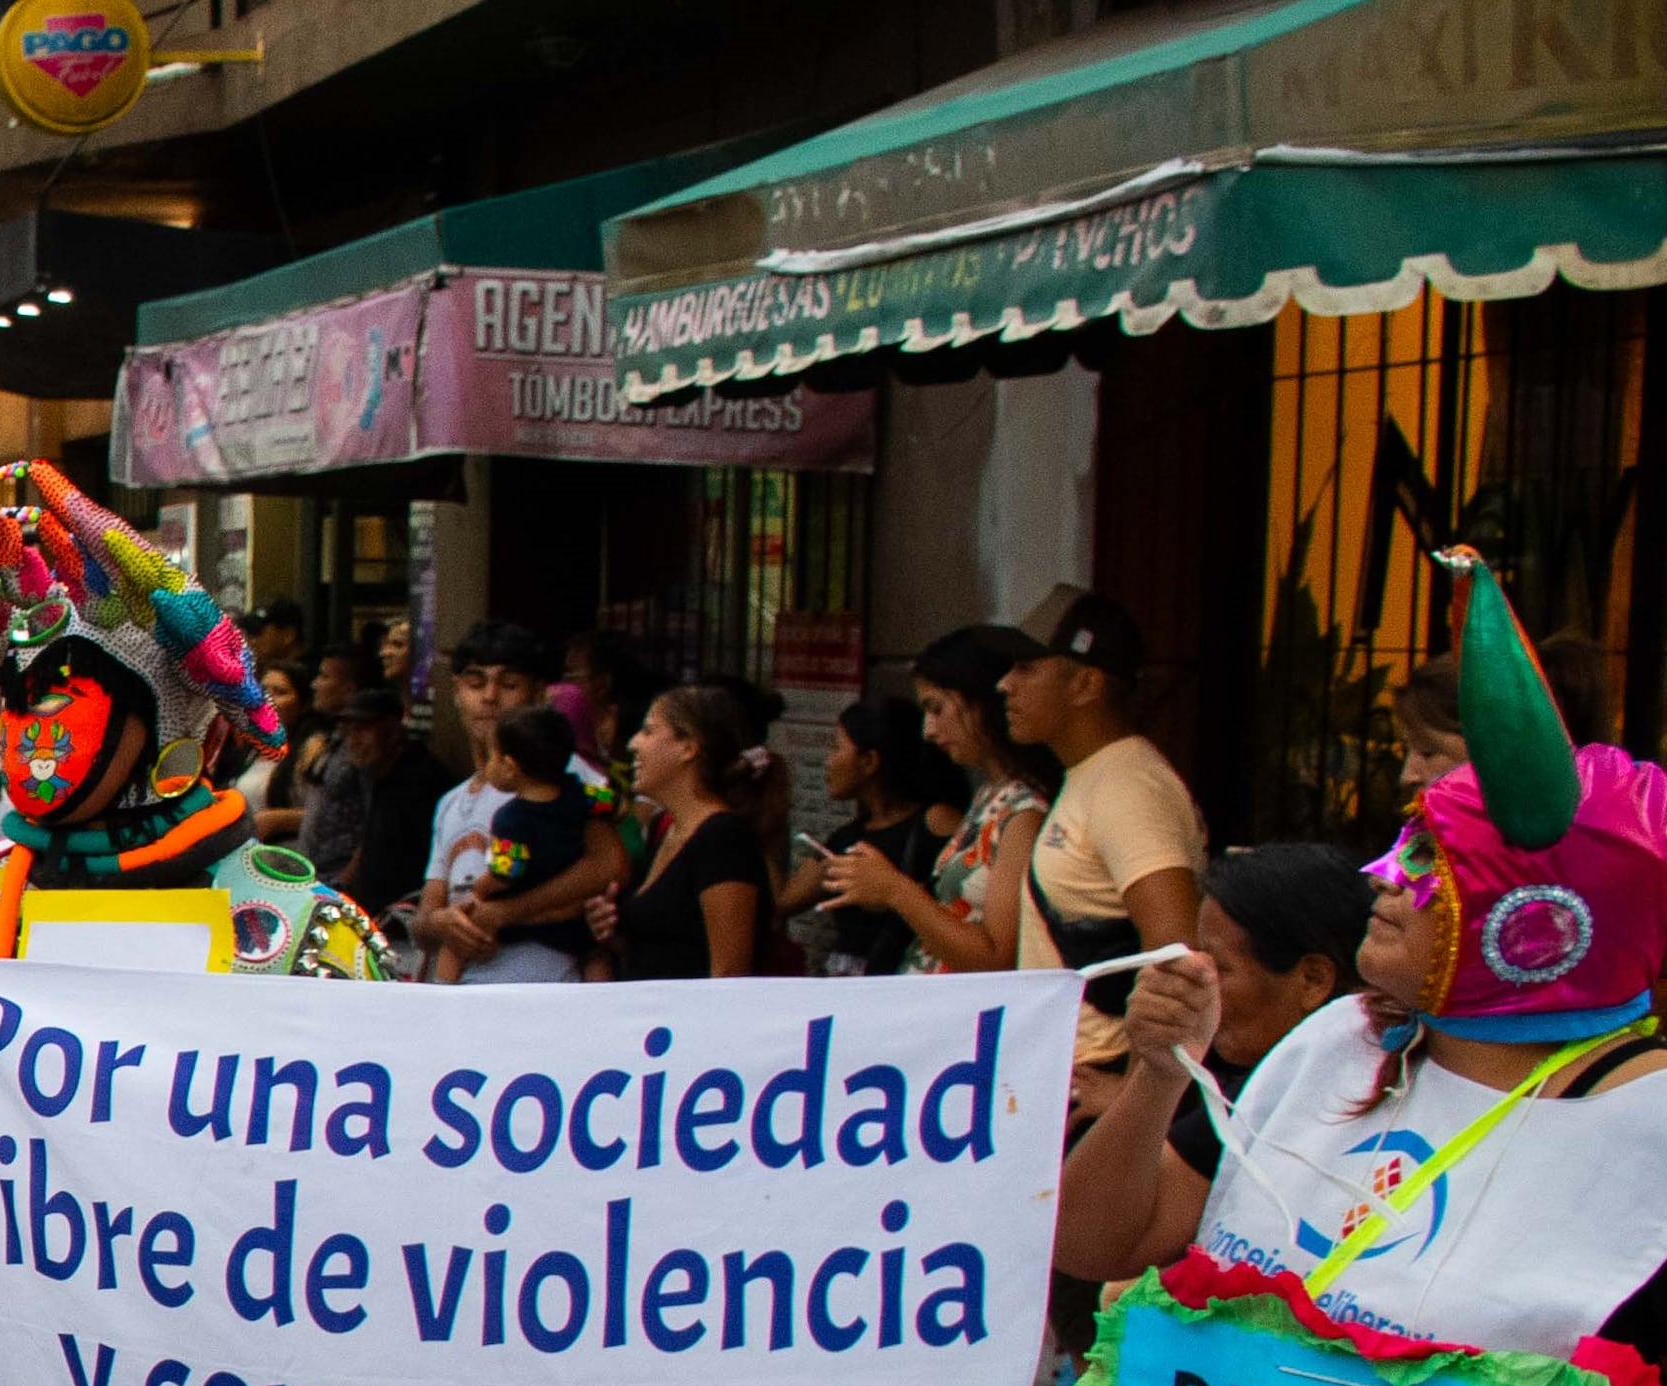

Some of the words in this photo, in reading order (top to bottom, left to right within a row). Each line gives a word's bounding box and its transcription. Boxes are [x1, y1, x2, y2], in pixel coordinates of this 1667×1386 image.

[21, 28, 129, 57] PAGO
[474, 279, 618, 358] AGEN
[167, 1049, 393, 1160] una
[421, 1006, 1006, 1175] sociedad
[225, 1179, 370, 1335] de
[402, 1197, 990, 1354] violencia
